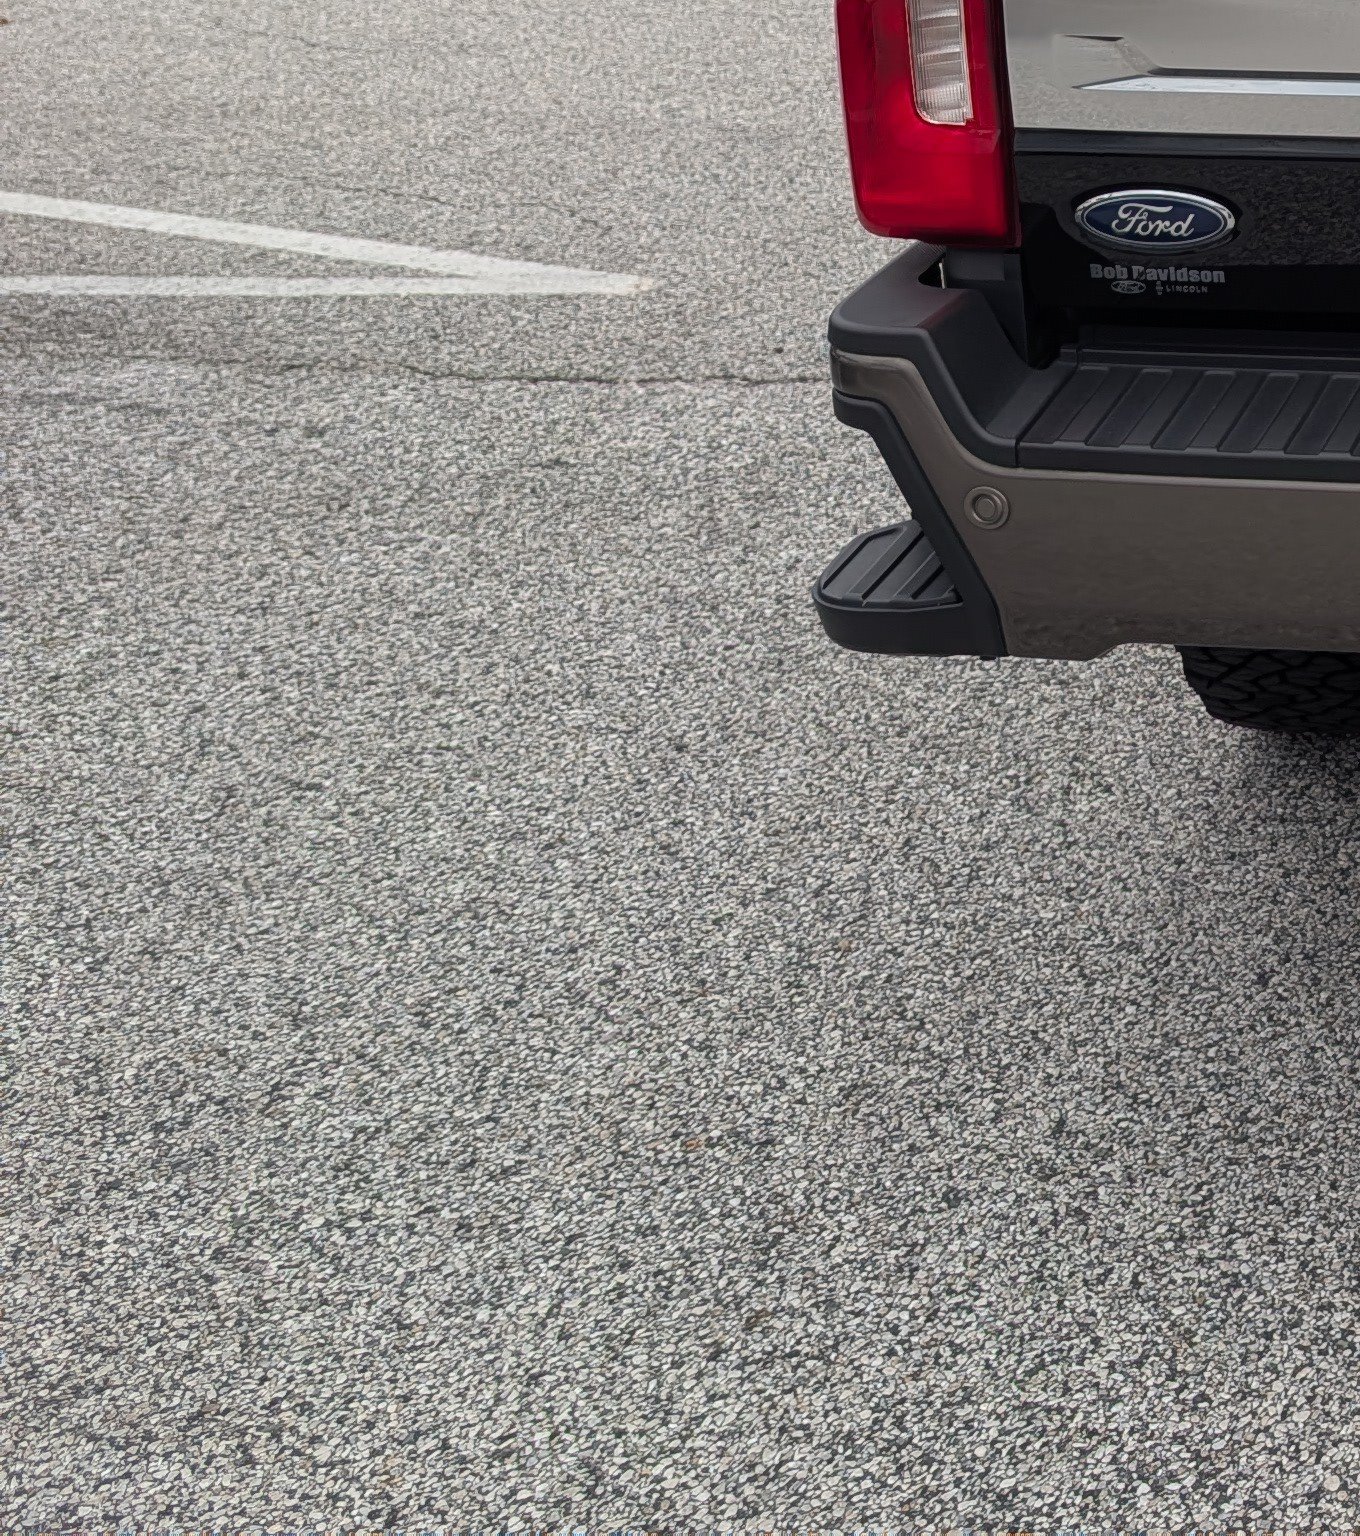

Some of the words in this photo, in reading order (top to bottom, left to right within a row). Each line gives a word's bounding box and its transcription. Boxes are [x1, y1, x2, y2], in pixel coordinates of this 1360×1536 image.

[1110, 201, 1195, 240] Ford
[1089, 263, 1129, 280] Bob
[1132, 265, 1226, 283] Davidson
[1165, 284, 1208, 294] LINCOLN
